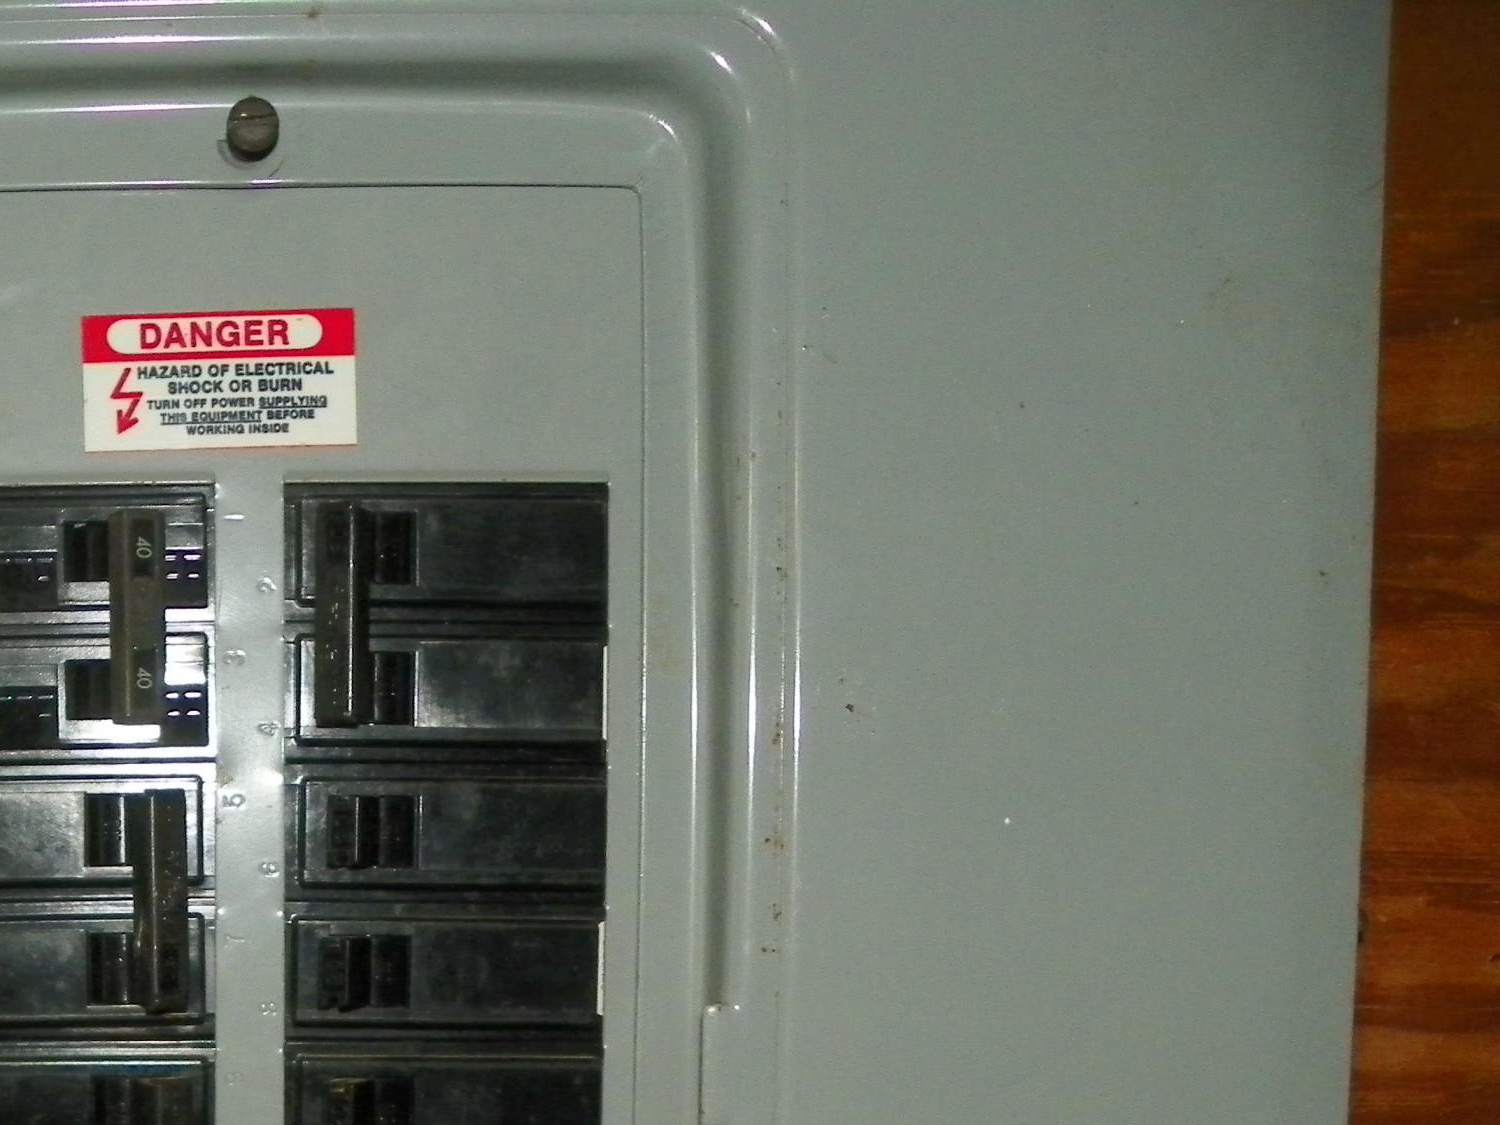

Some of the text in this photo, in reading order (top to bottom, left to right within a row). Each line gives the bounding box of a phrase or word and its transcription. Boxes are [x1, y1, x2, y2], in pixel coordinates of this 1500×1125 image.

[139, 320, 290, 350] DANGER
[138, 361, 334, 379] HAZARD OF ELECTRICAL
[168, 378, 302, 395] SHOCK OR BURN
[148, 395, 328, 410] TURN OFF POWER SUPPLYING
[160, 410, 314, 423] THIS EQUIPMENT BEFORE
[187, 423, 289, 435] WORKING INSIDE
[136, 535, 152, 559] 40
[136, 667, 152, 689] 40
[222, 793, 245, 808] 5
